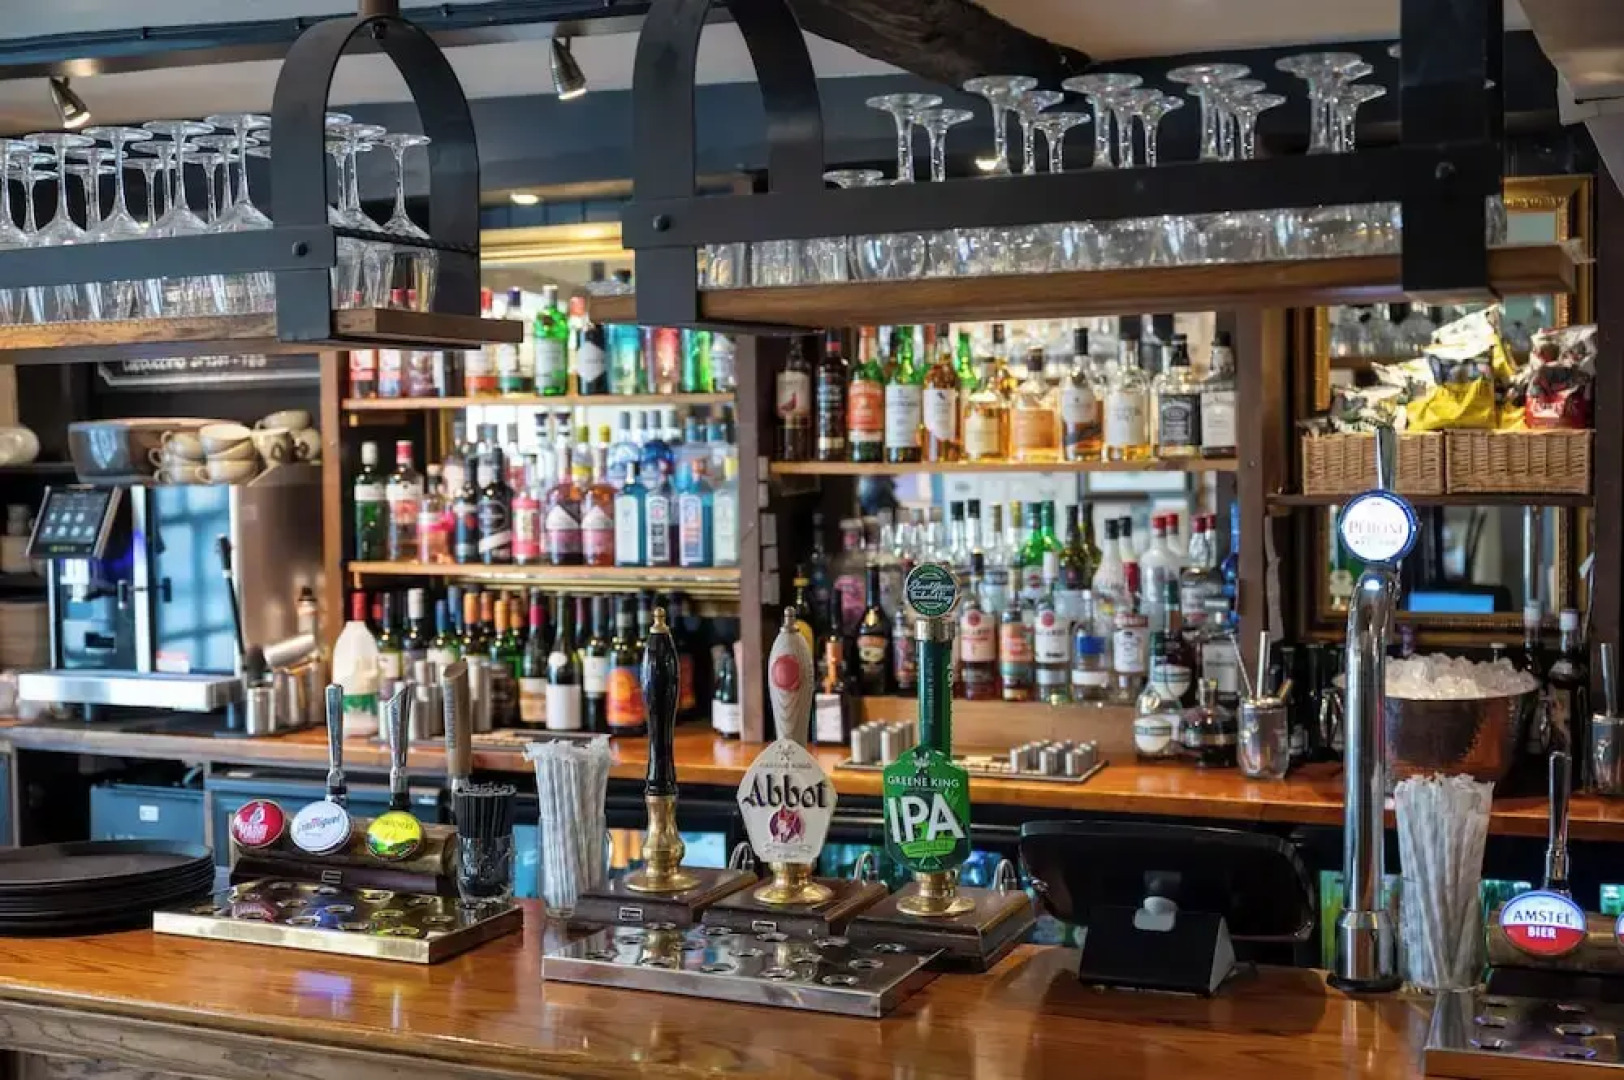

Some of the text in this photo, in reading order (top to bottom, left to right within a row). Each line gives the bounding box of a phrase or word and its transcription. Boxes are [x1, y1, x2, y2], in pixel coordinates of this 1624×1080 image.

[888, 774, 960, 787] GREENE KING
[742, 772, 828, 808] Abbot
[887, 793, 966, 844] IPA
[1513, 910, 1571, 925] AMSTEL
[1527, 926, 1557, 939] BIER
